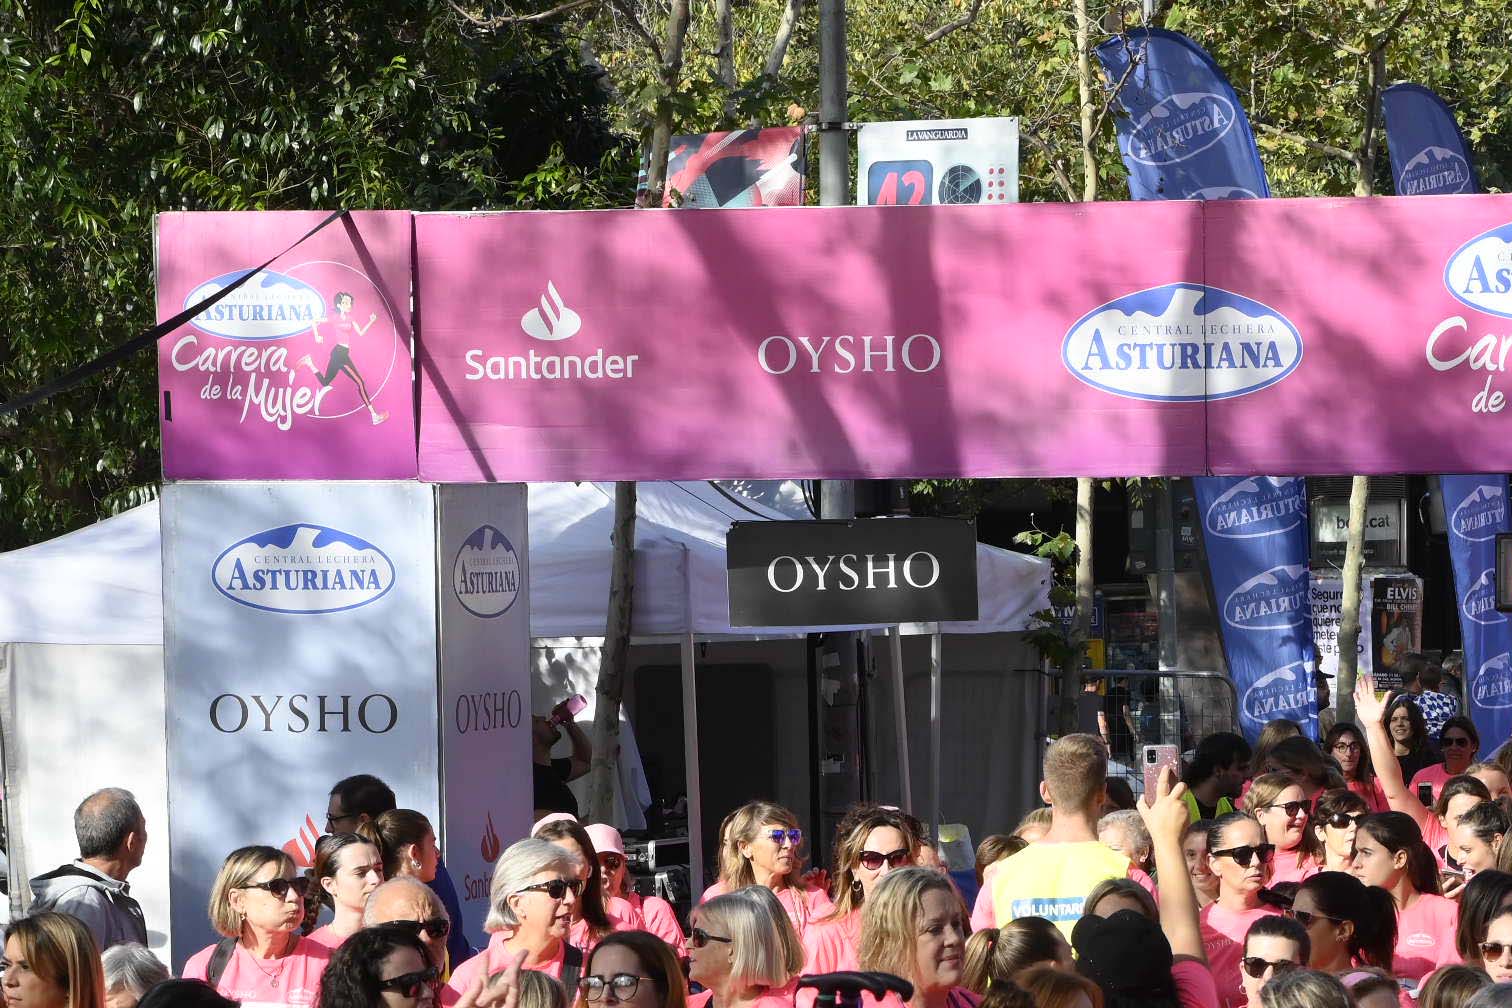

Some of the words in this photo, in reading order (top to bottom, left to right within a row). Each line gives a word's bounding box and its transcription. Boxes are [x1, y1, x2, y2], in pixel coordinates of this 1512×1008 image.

[920, 129, 967, 140] VANGUARDIA
[195, 296, 314, 321] ASTURIANA
[1118, 325, 1193, 336] CENTRAL
[1201, 323, 1276, 335] LECHERA
[171, 335, 288, 373] Carrera
[465, 349, 639, 380] Santander
[757, 334, 941, 375] OYSHO
[1081, 329, 1283, 371] ASTURIANA
[200, 374, 221, 400] de
[227, 373, 242, 400] la
[240, 370, 333, 431] Mujer
[1471, 376, 1505, 414] de
[227, 557, 382, 592] ASTURIANA
[254, 555, 312, 564] CENTRAL
[318, 555, 376, 564] LECHERA
[768, 552, 939, 592] OYSHO
[458, 560, 516, 595] ASTURIANA
[1387, 588, 1417, 600] ELVIS
[1312, 604, 1329, 617] que
[1313, 616, 1343, 630] quiere
[1313, 630, 1338, 641] mete
[209, 693, 398, 734] OYSHO
[456, 689, 522, 735] OYSHO
